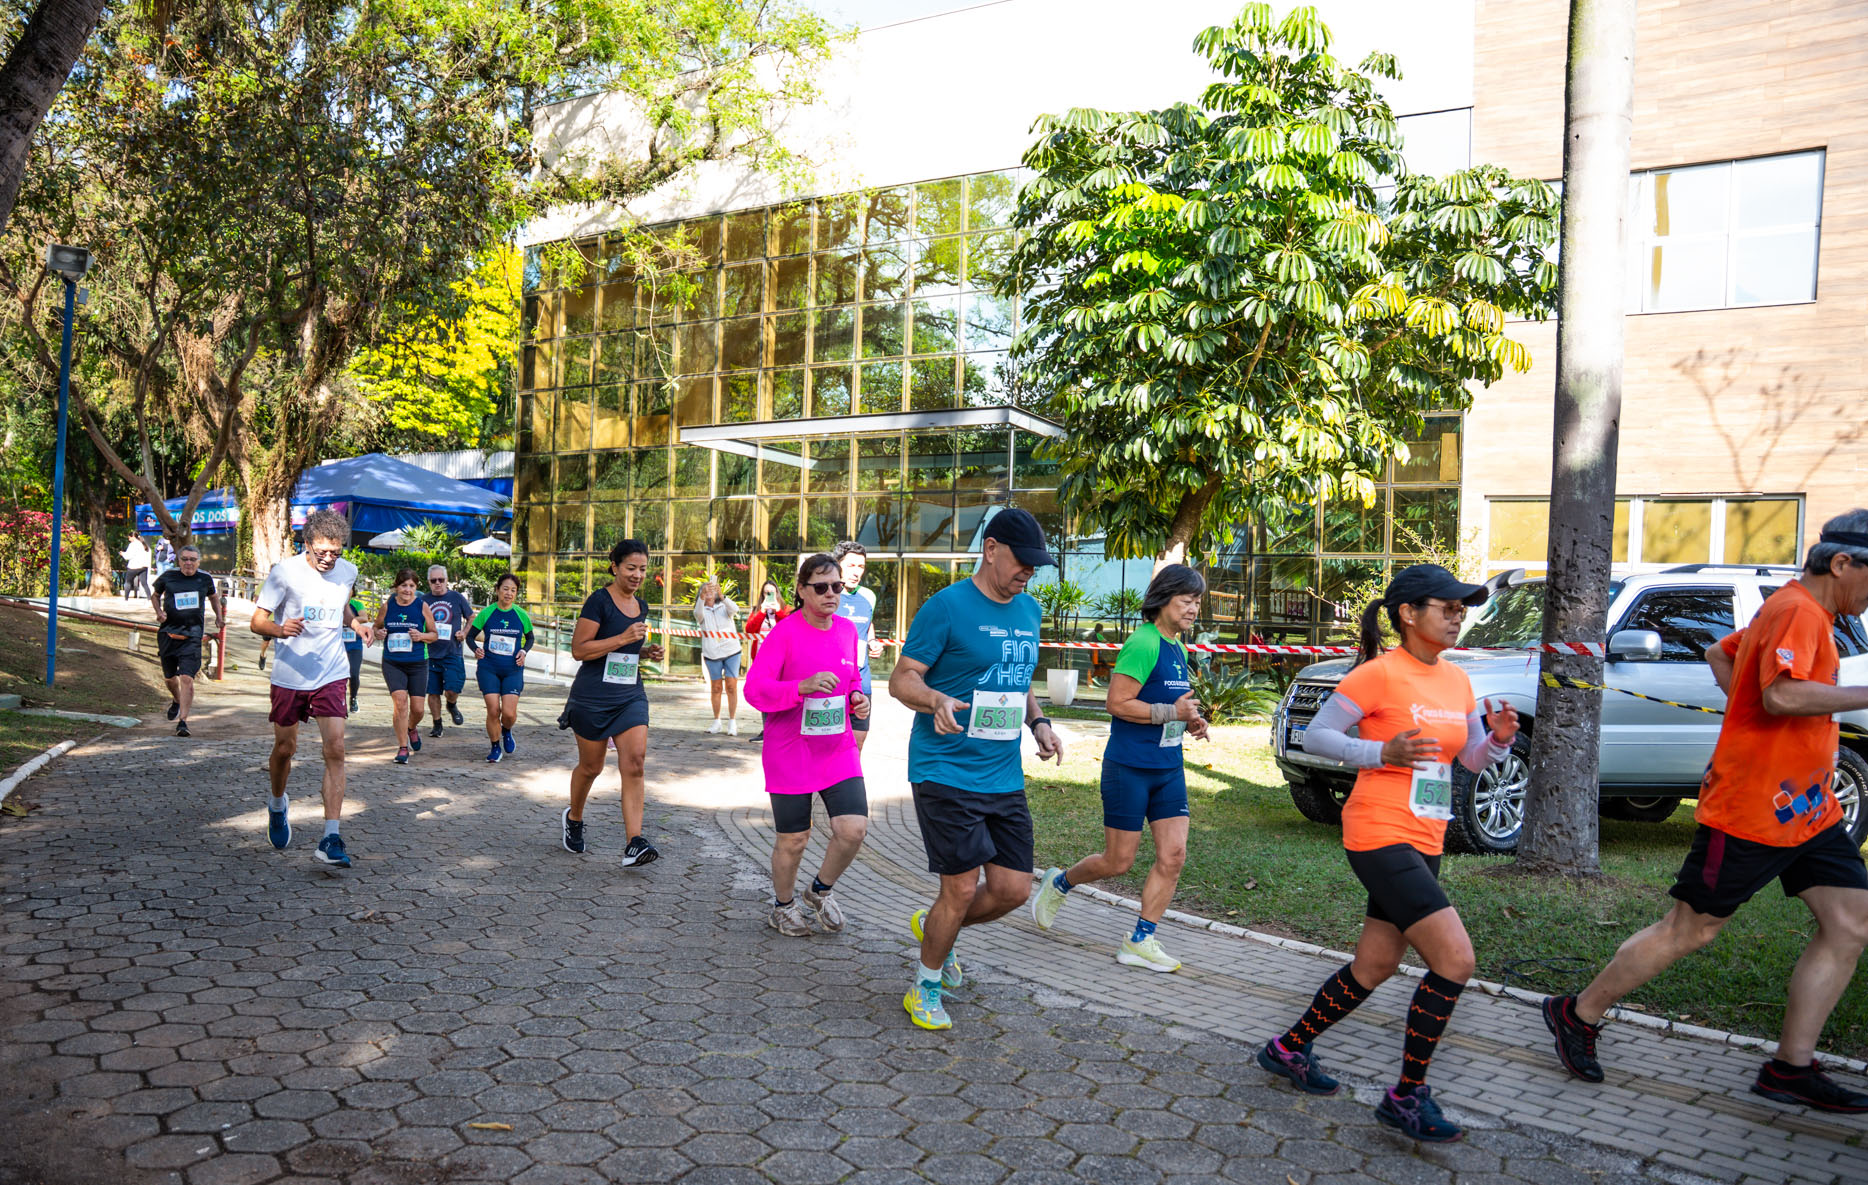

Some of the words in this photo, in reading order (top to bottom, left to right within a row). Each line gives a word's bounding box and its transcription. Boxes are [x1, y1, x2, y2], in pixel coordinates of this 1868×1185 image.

[208, 511, 227, 522] DOS
[307, 607, 337, 621] 307
[611, 663, 636, 677] 535
[810, 710, 841, 727] 536
[980, 709, 1018, 729] 531
